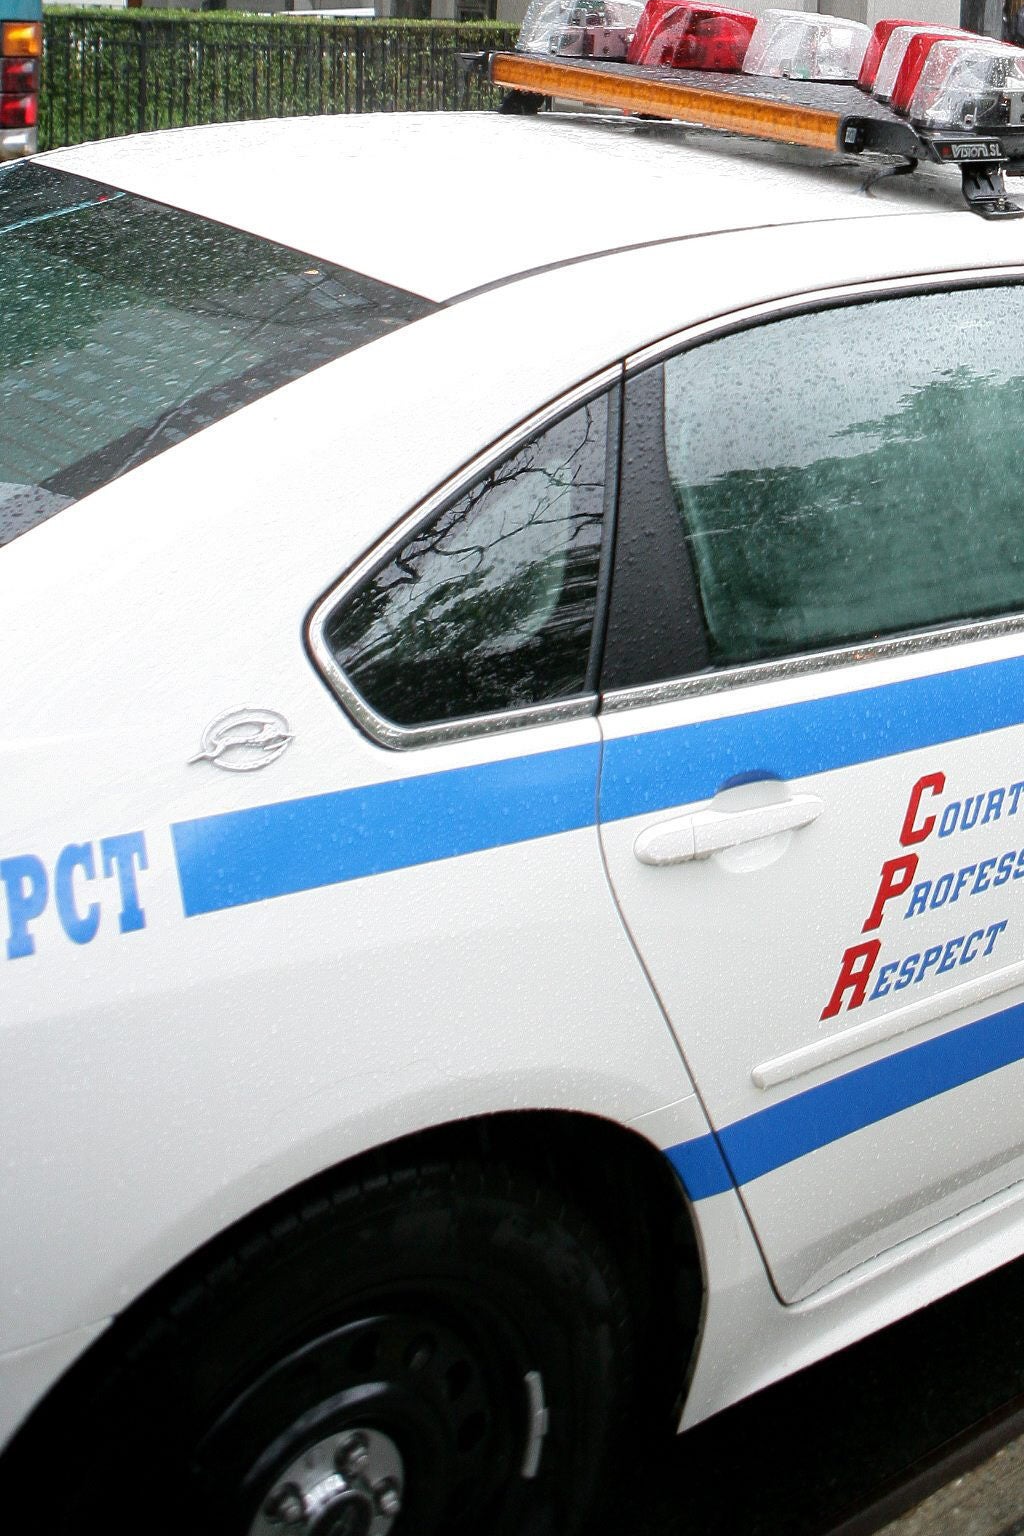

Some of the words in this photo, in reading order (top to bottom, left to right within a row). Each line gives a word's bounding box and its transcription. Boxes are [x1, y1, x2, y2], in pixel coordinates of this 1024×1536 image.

[989, 144, 1002, 157] SL
[0, 830, 149, 961] PCT
[819, 919, 1009, 1022] RESPECT
